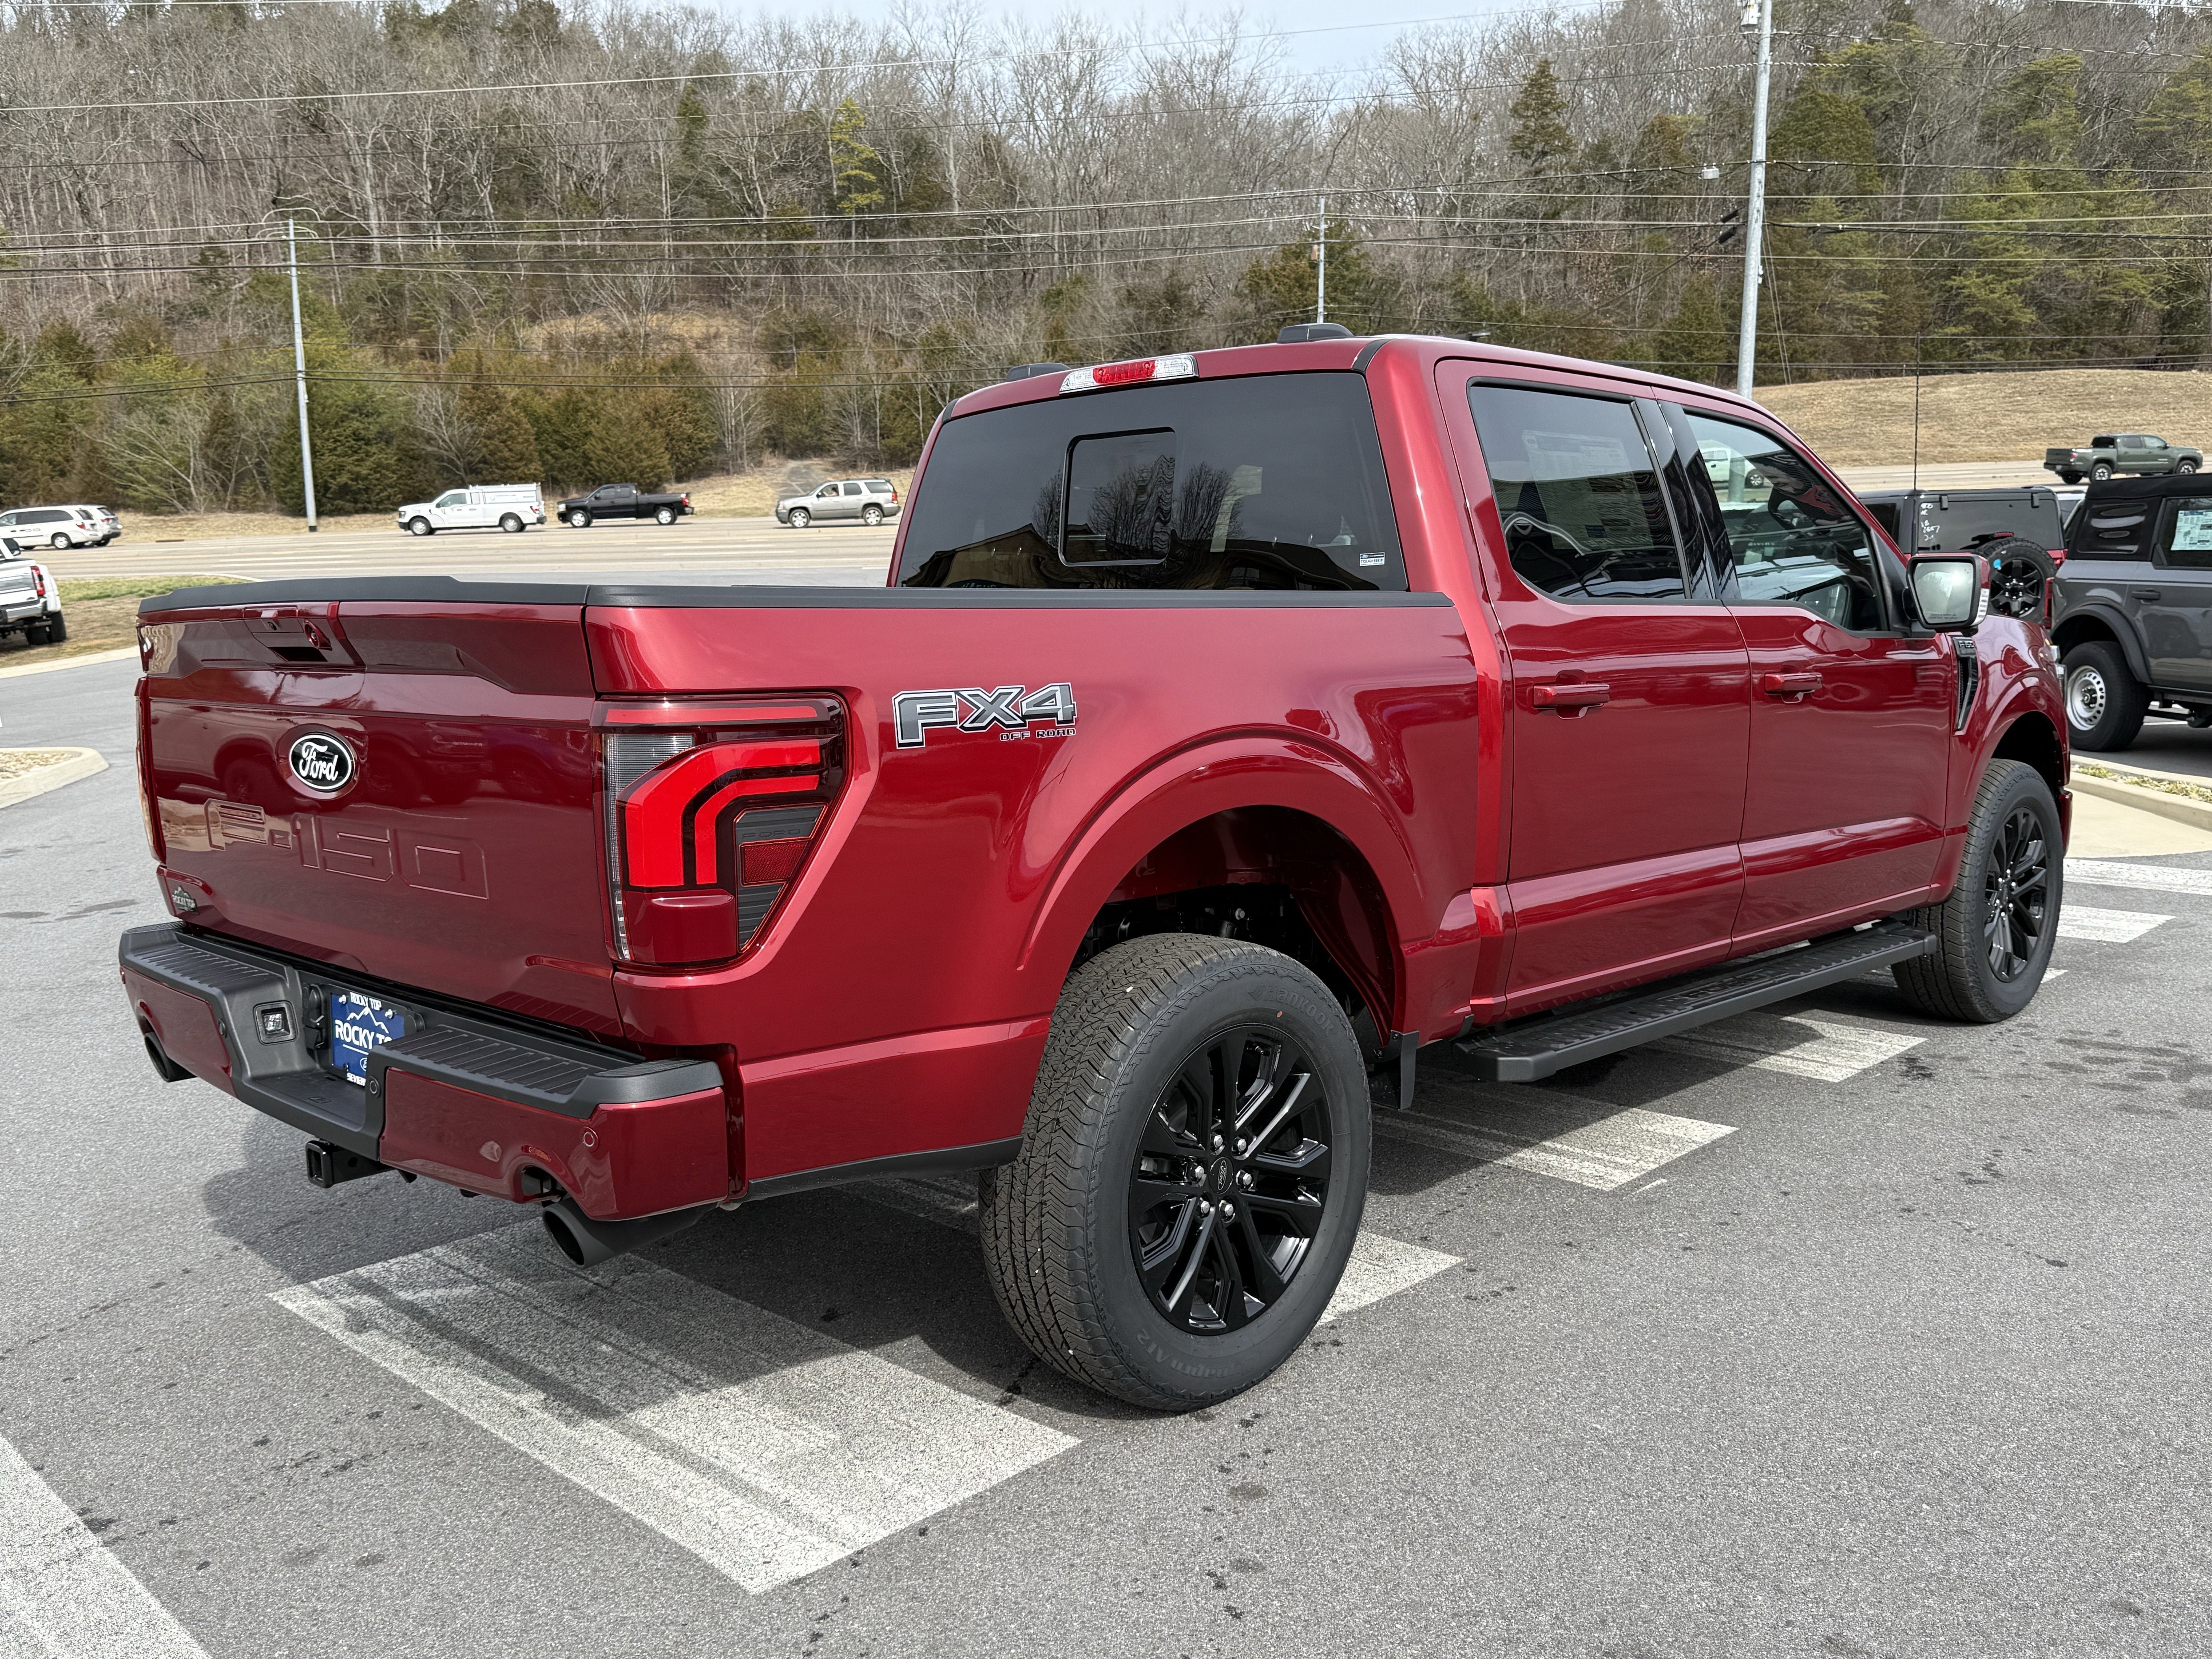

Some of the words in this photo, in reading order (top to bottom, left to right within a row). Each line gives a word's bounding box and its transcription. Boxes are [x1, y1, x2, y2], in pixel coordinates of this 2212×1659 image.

[891, 682, 1077, 749] FX4
[1000, 732, 1030, 742] OFF
[1036, 728, 1076, 738] ROAD
[299, 741, 338, 781] Ford
[204, 798, 489, 900] F-150
[742, 828, 800, 839] FORD
[350, 992, 369, 1007] ROCKY
[369, 998, 382, 1011] TOP
[1262, 985, 1336, 1037] Hankook
[335, 1019, 375, 1049] ROCKY
